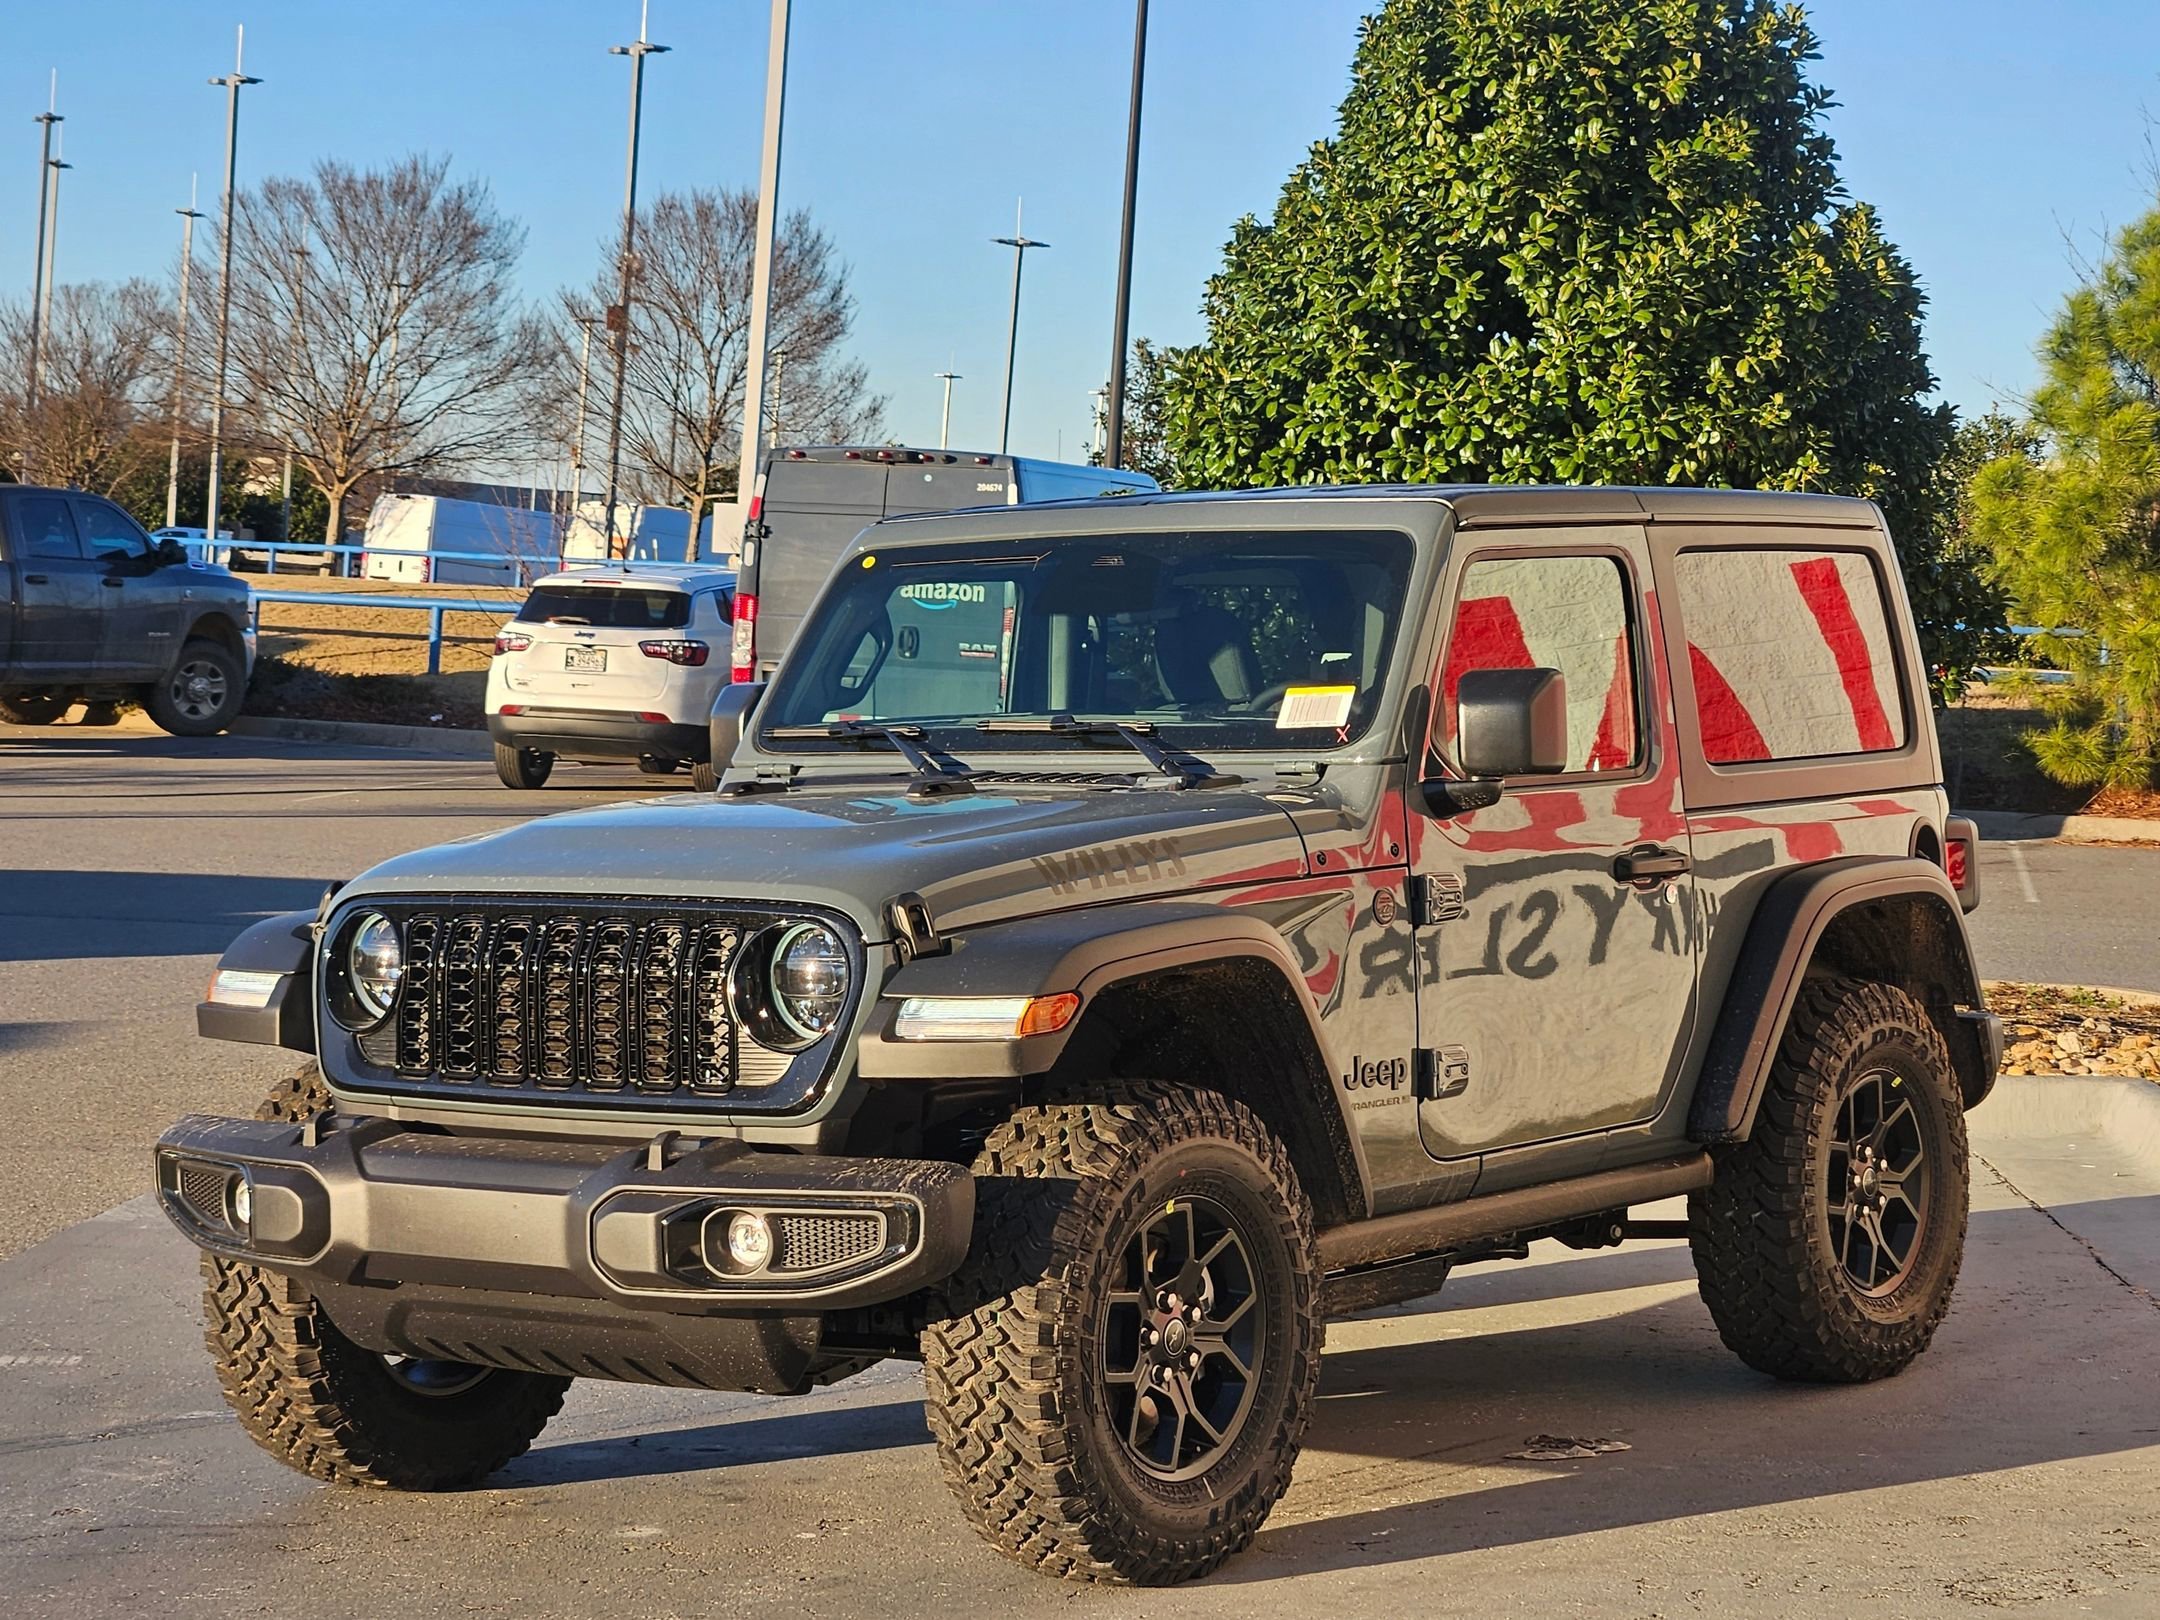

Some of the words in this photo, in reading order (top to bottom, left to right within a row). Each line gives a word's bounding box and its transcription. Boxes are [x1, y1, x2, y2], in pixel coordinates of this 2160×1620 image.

[900, 583, 985, 602] amazon
[1030, 836, 1187, 896] WILLYS
[1343, 1055, 1408, 1091] Jeep
[1351, 1096, 1401, 1111] RANGLER
